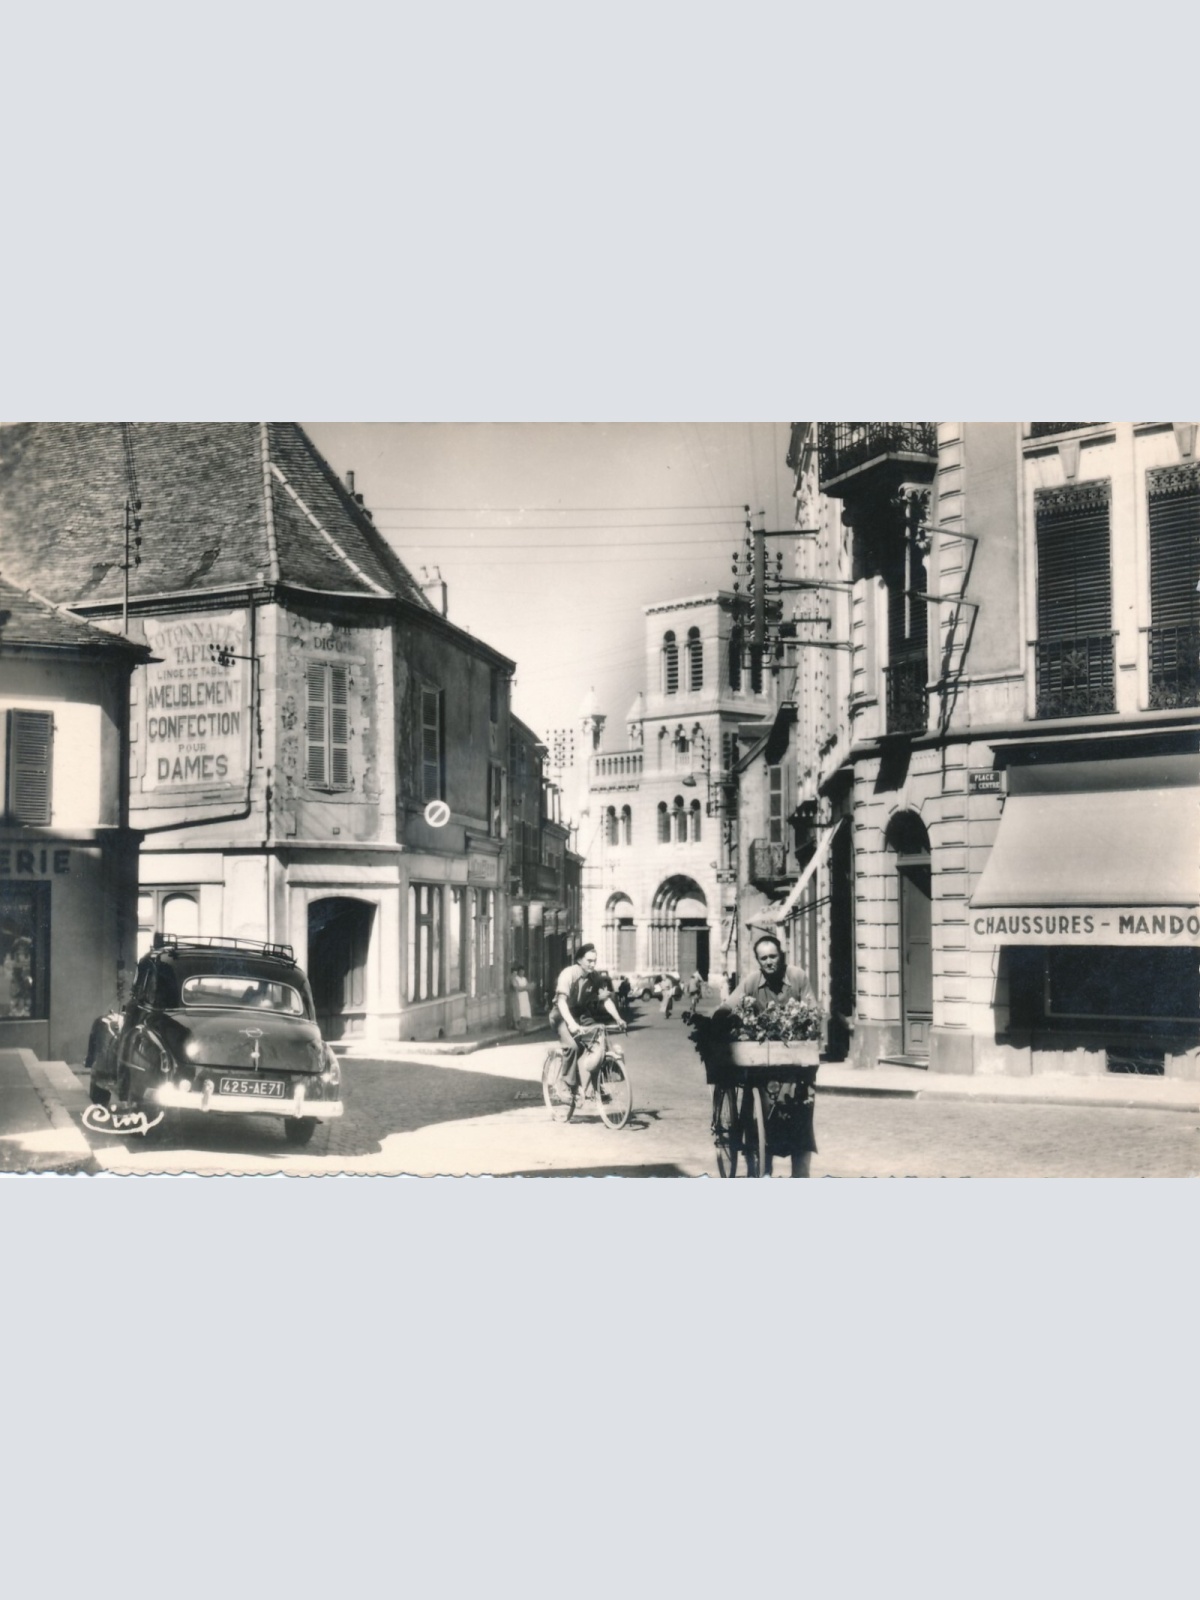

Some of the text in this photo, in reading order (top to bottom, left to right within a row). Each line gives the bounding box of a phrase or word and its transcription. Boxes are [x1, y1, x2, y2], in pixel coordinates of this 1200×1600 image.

[187, 667, 199, 678] DE
[147, 680, 241, 709] AMEUBLEMENT
[148, 711, 240, 740] CONFECTION
[178, 743, 207, 753] POUR
[157, 754, 229, 781] DAMES
[974, 773, 994, 782] PLACE
[978, 781, 1000, 790] CENTRE
[973, 915, 1095, 935] CHAUSSURES
